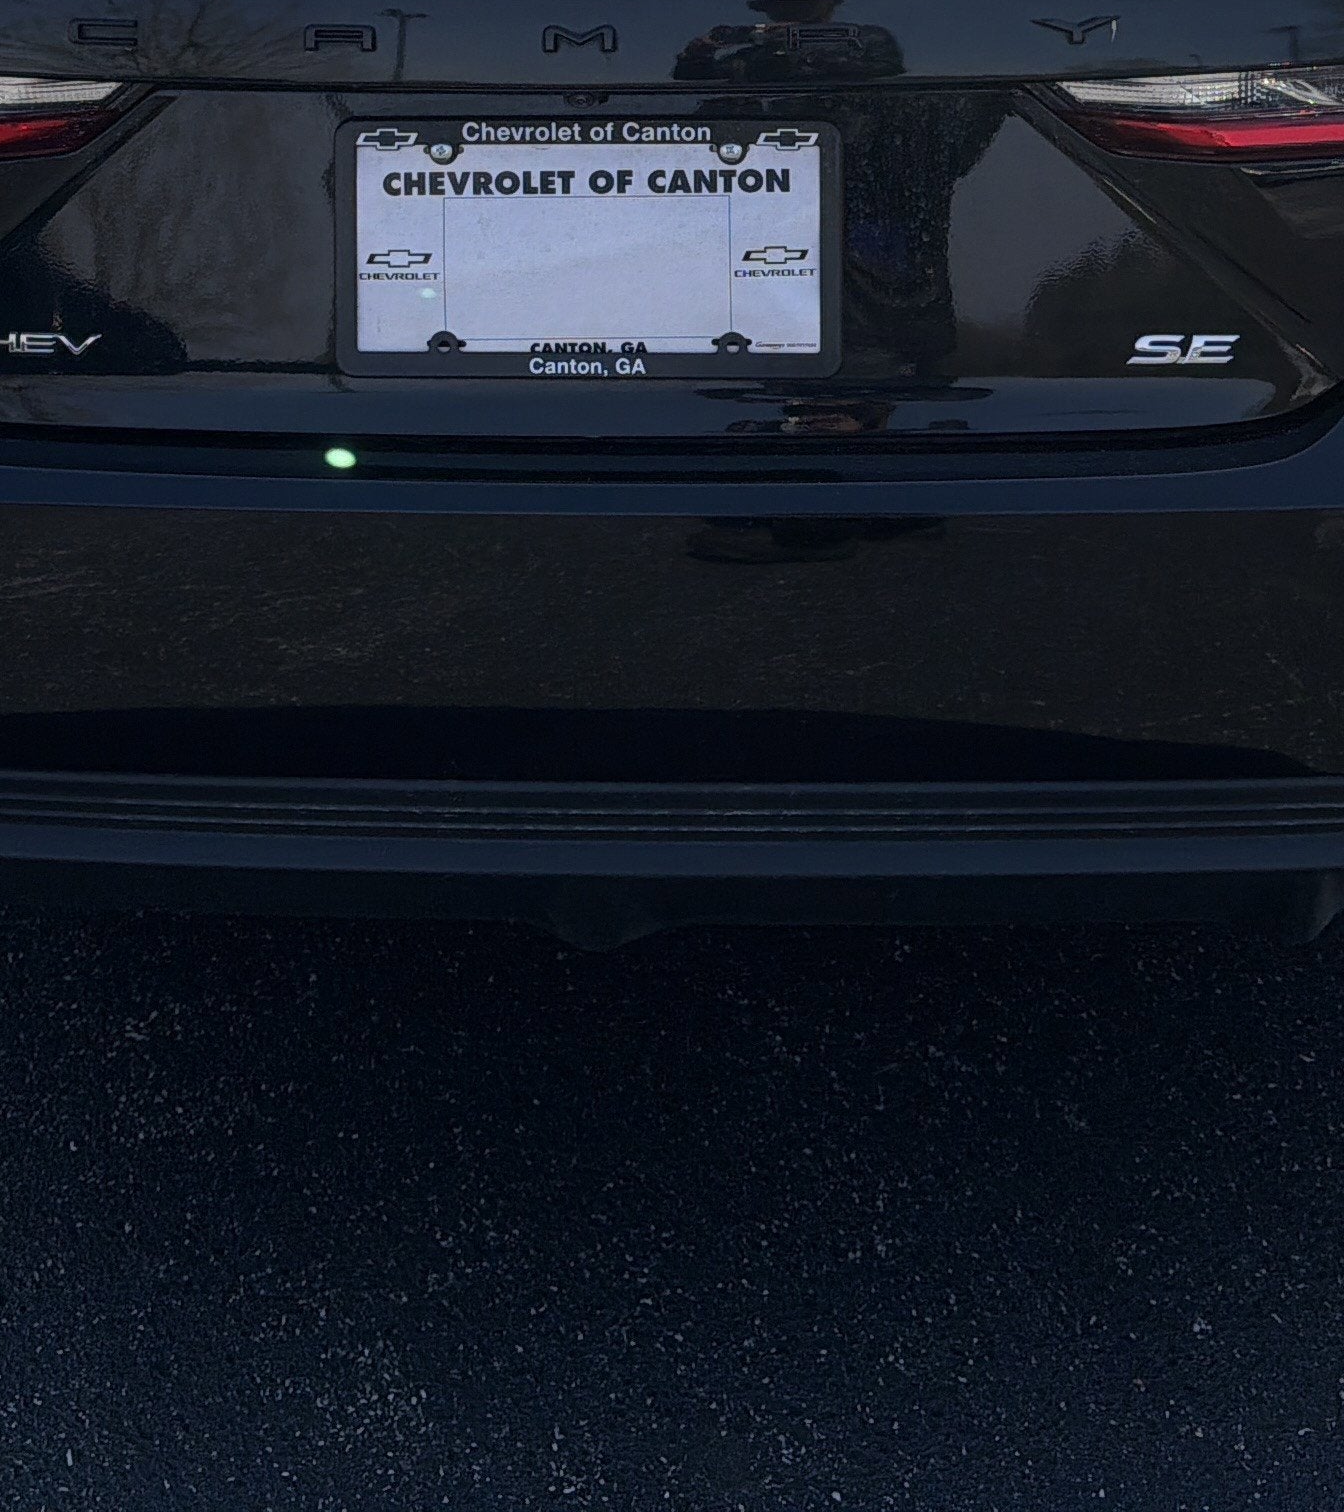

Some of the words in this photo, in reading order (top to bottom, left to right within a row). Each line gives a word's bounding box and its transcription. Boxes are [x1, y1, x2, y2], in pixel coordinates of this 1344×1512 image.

[462, 122, 581, 142] Chevrolet
[590, 122, 614, 142] of
[622, 122, 711, 142] Canton
[383, 171, 575, 196] CHEVROLET
[588, 170, 633, 194] OF
[647, 169, 791, 193] CANTON
[359, 272, 440, 281] CHEVROLET
[734, 268, 816, 278] CHEVROLET
[621, 341, 648, 353] GA
[1125, 334, 1241, 365] SE
[529, 357, 609, 377] Canton,
[616, 357, 647, 375] GA
